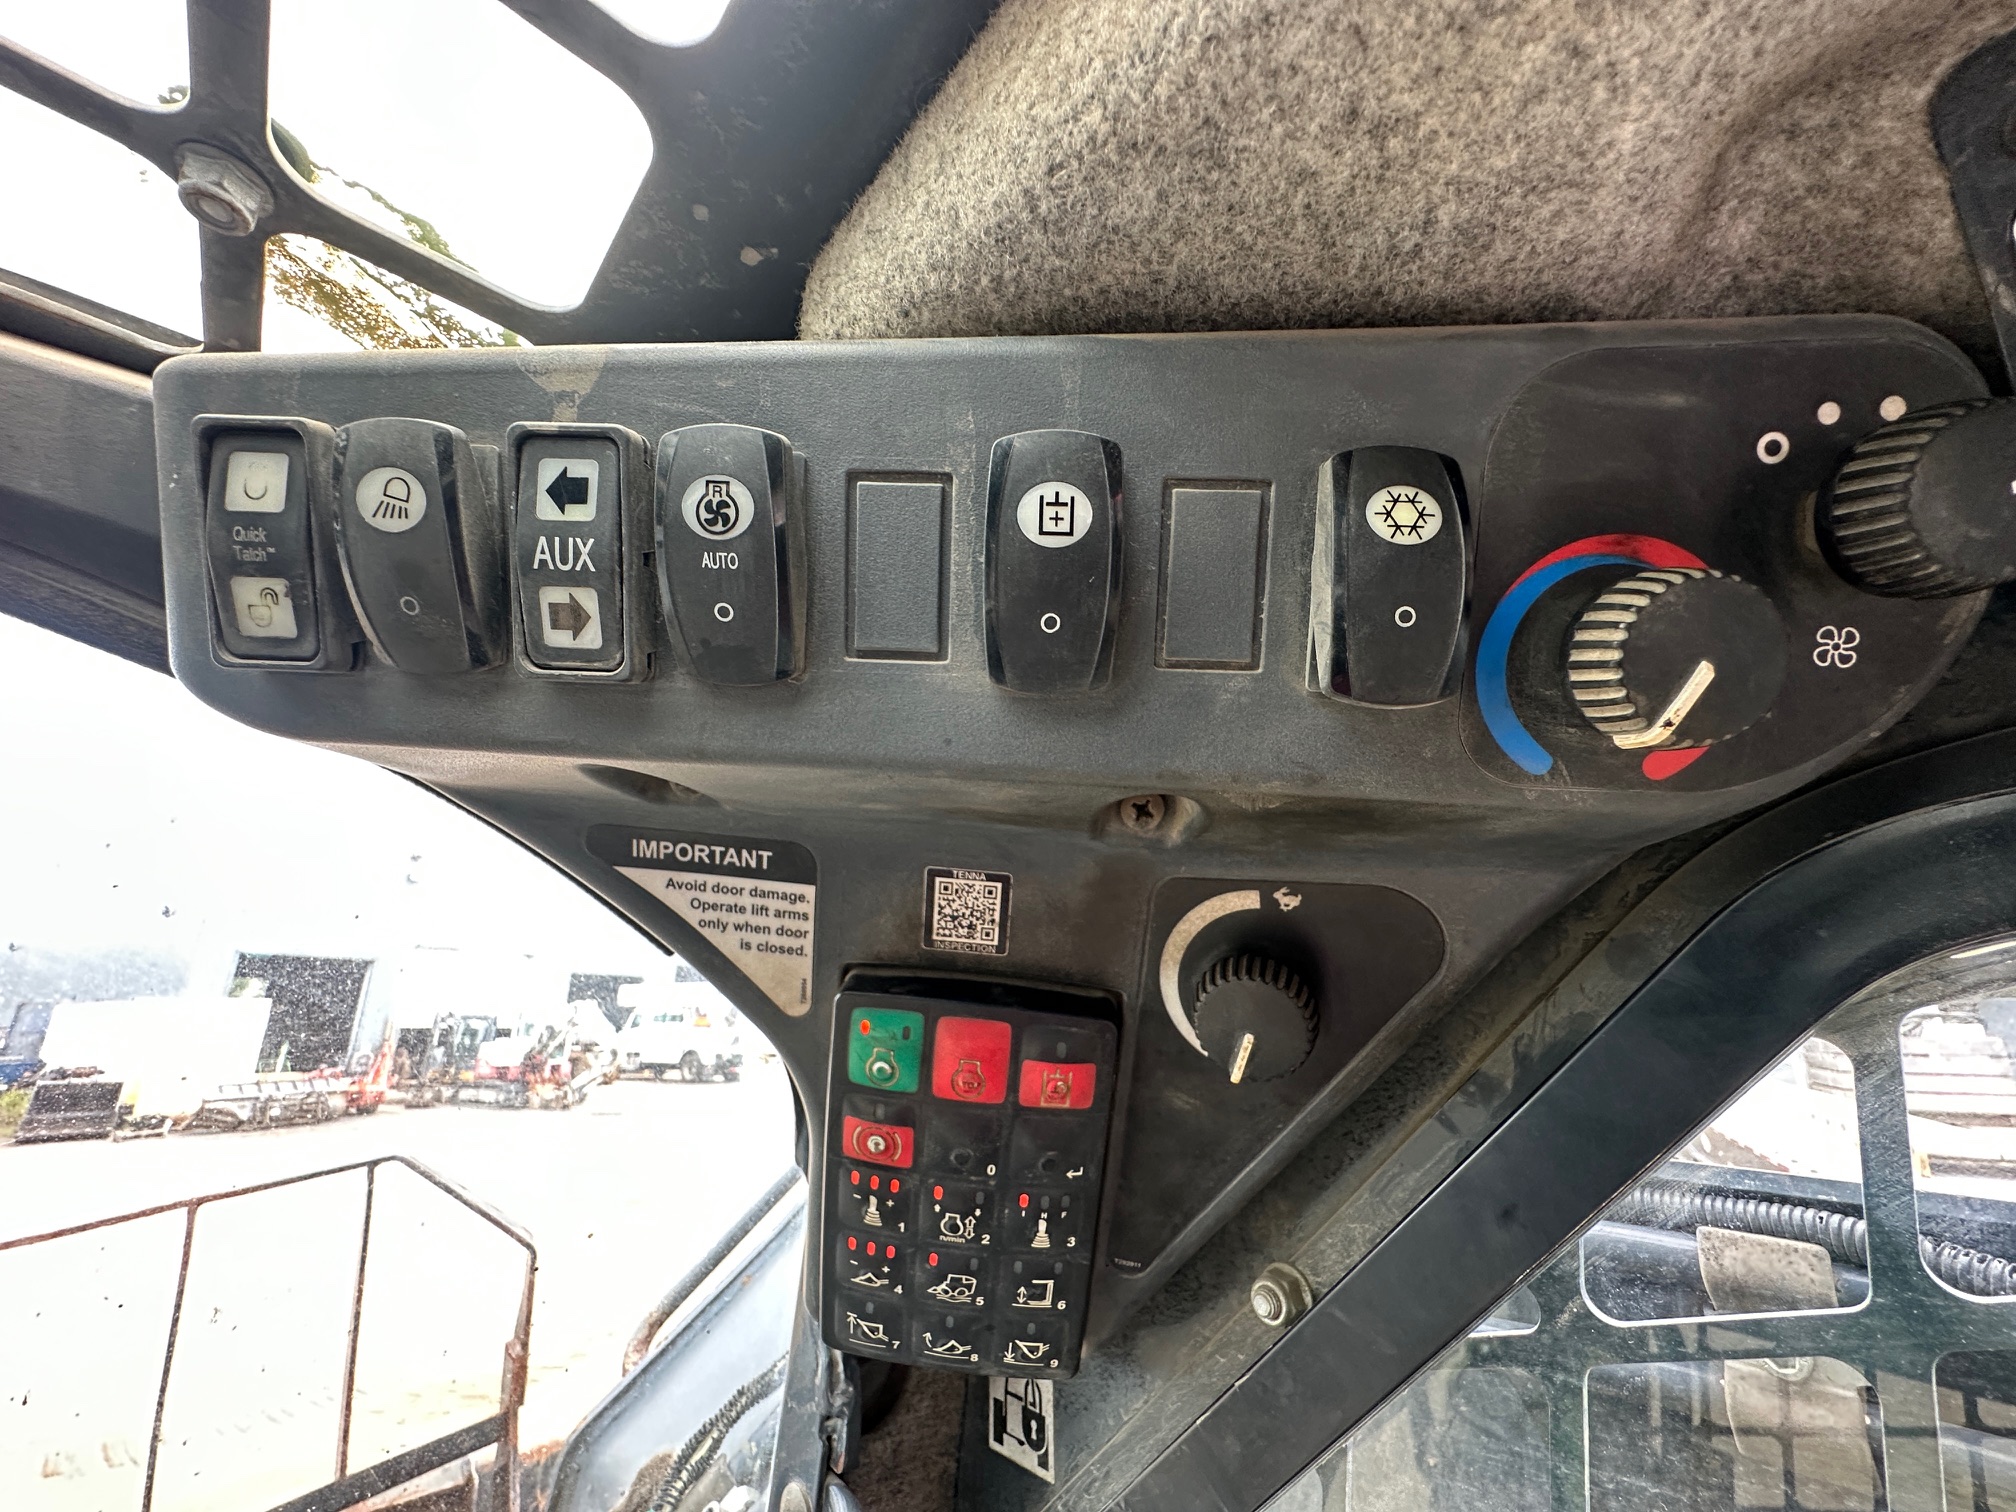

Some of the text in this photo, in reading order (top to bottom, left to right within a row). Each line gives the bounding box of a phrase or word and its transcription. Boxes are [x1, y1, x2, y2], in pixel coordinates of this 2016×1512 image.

[712, 485, 723, 498] R
[533, 536, 596, 572] AUX
[702, 551, 739, 569] AUTO
[631, 838, 773, 870] IMPORTANT
[953, 870, 987, 881] TENNA
[665, 877, 811, 906] Avoid door damage.
[690, 897, 810, 921] Operate lift arms
[698, 918, 810, 939] only when door
[740, 938, 808, 957] is closed.
[935, 941, 997, 954] INSPECTION
[986, 1164, 996, 1176] 0
[1060, 1211, 1068, 1219] F
[897, 1222, 905, 1233] 1
[981, 1233, 991, 1245] 2
[1066, 1236, 1076, 1247] 3
[893, 1284, 903, 1295] 4
[975, 1296, 985, 1306] 5
[1056, 1300, 1067, 1310] 6
[891, 1341, 901, 1349] 7
[970, 1353, 979, 1362] 8
[1049, 1358, 1059, 1368] 9
